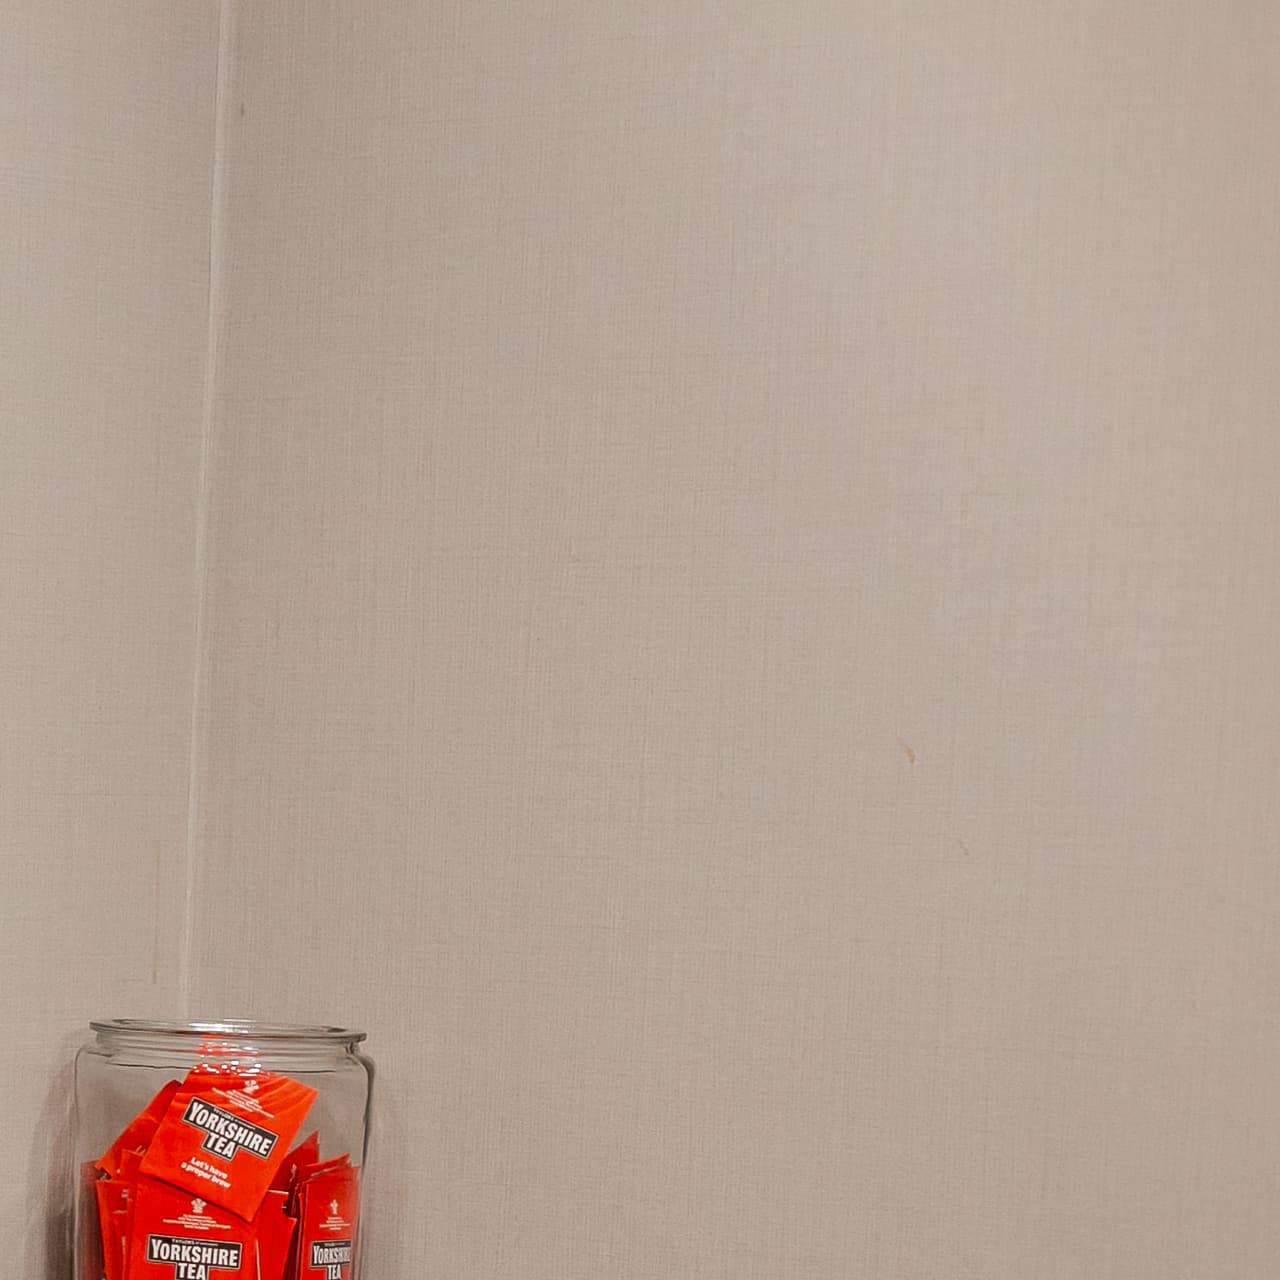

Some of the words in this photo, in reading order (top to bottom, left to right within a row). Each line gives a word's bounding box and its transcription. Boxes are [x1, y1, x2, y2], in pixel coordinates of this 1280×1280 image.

[188, 1101, 273, 1156] YORKSHIRE
[206, 1132, 237, 1158] TEA
[151, 1239, 239, 1267] YORKSHIRE
[178, 1263, 207, 1280] TEA
[328, 1265, 342, 1280] TEA
